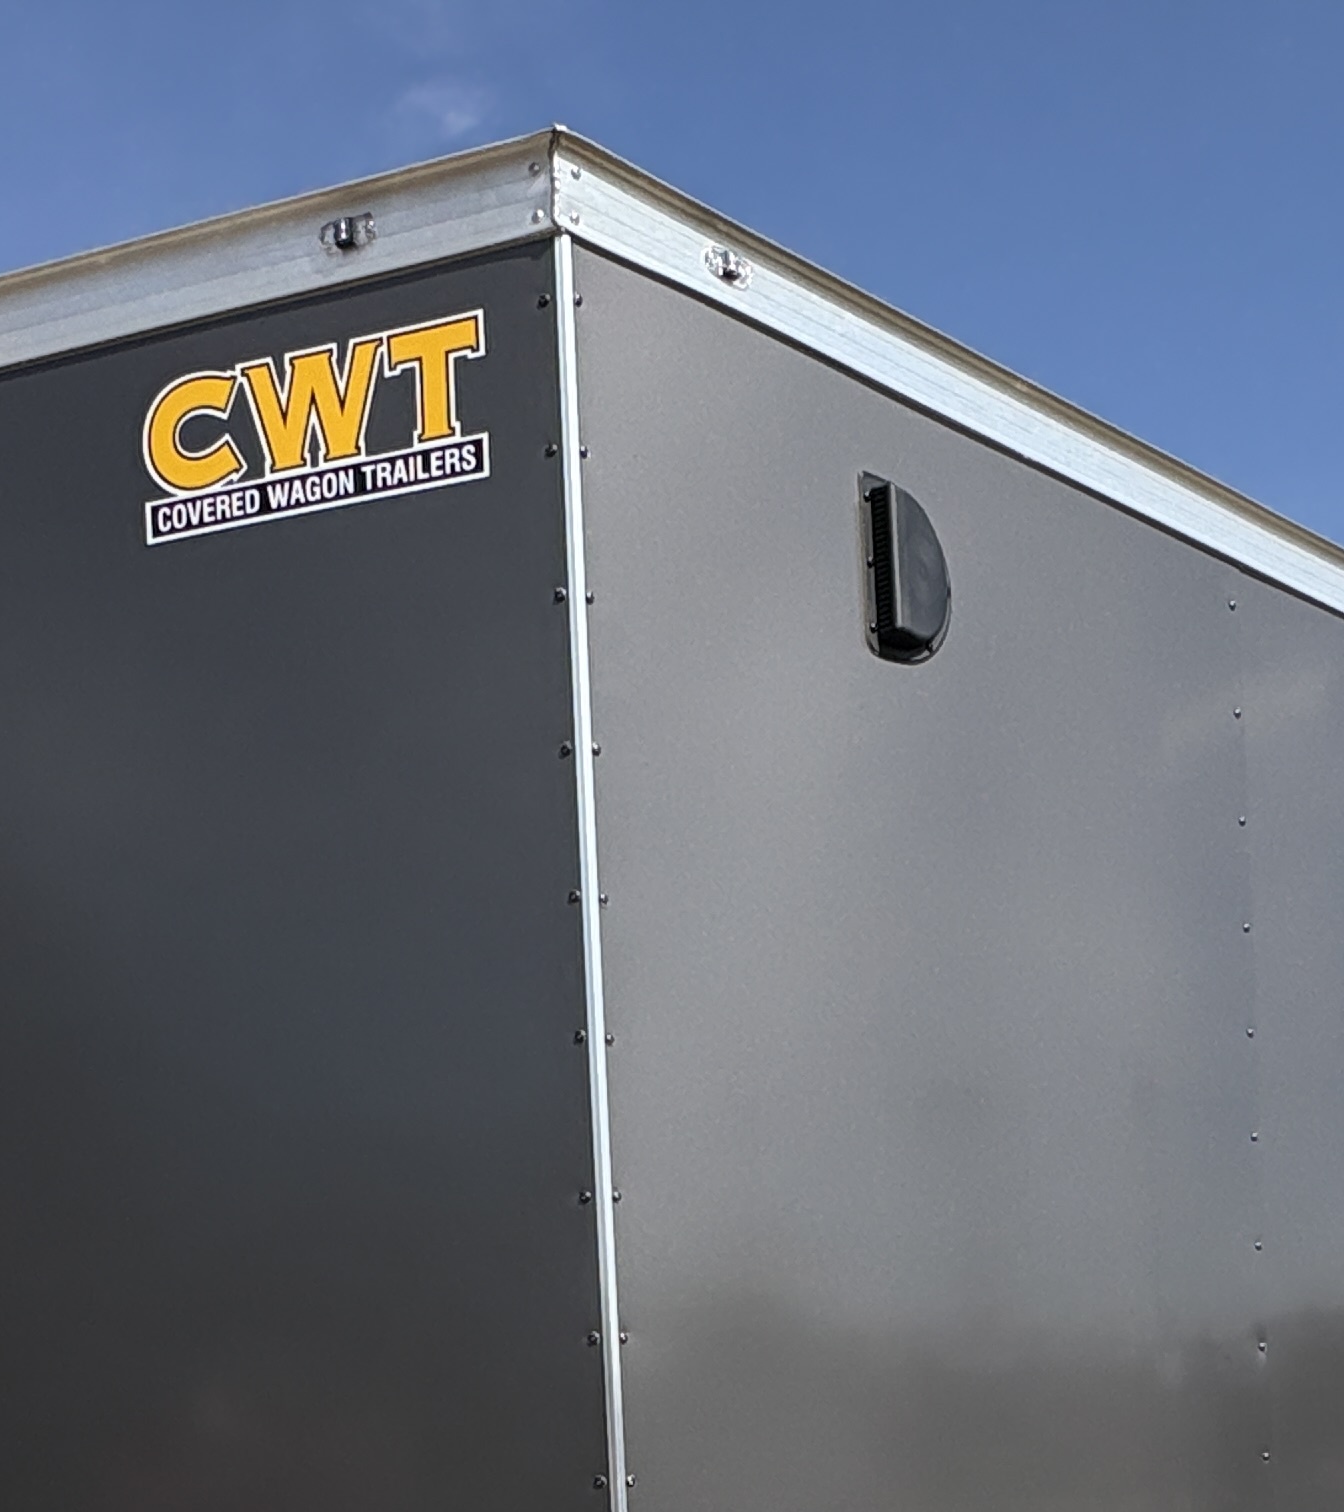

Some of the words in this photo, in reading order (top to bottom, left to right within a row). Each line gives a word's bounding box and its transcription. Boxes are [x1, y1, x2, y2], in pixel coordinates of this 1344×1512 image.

[145, 310, 484, 493] CWT
[157, 488, 260, 533] COVERED
[266, 468, 355, 510] WAGON
[361, 446, 477, 490] TRAILERS
